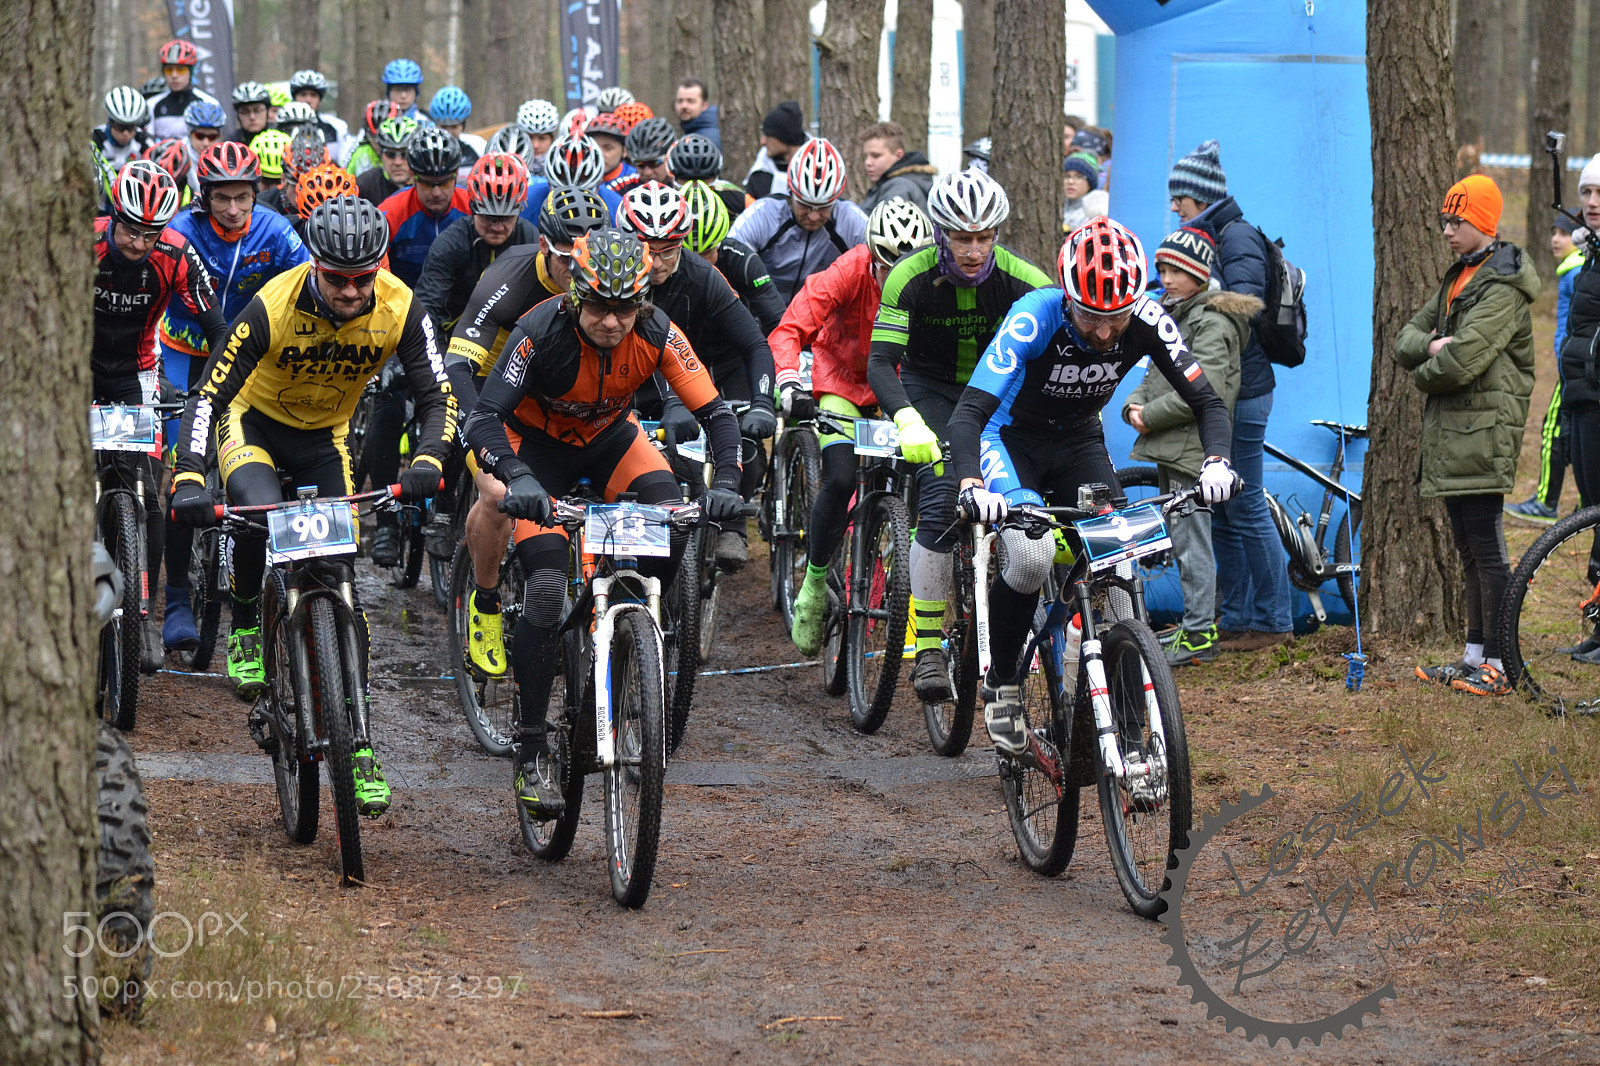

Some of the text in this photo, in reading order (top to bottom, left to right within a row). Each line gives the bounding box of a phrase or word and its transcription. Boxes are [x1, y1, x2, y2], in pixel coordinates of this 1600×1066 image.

[94, 287, 152, 305] PATNET
[474, 283, 510, 326] RENAULT
[279, 342, 384, 365] BARAN
[107, 414, 135, 436] 74
[873, 425, 900, 448] 65
[292, 513, 330, 542] 90
[612, 510, 646, 538] 13
[218, 534, 227, 567] SWISS
